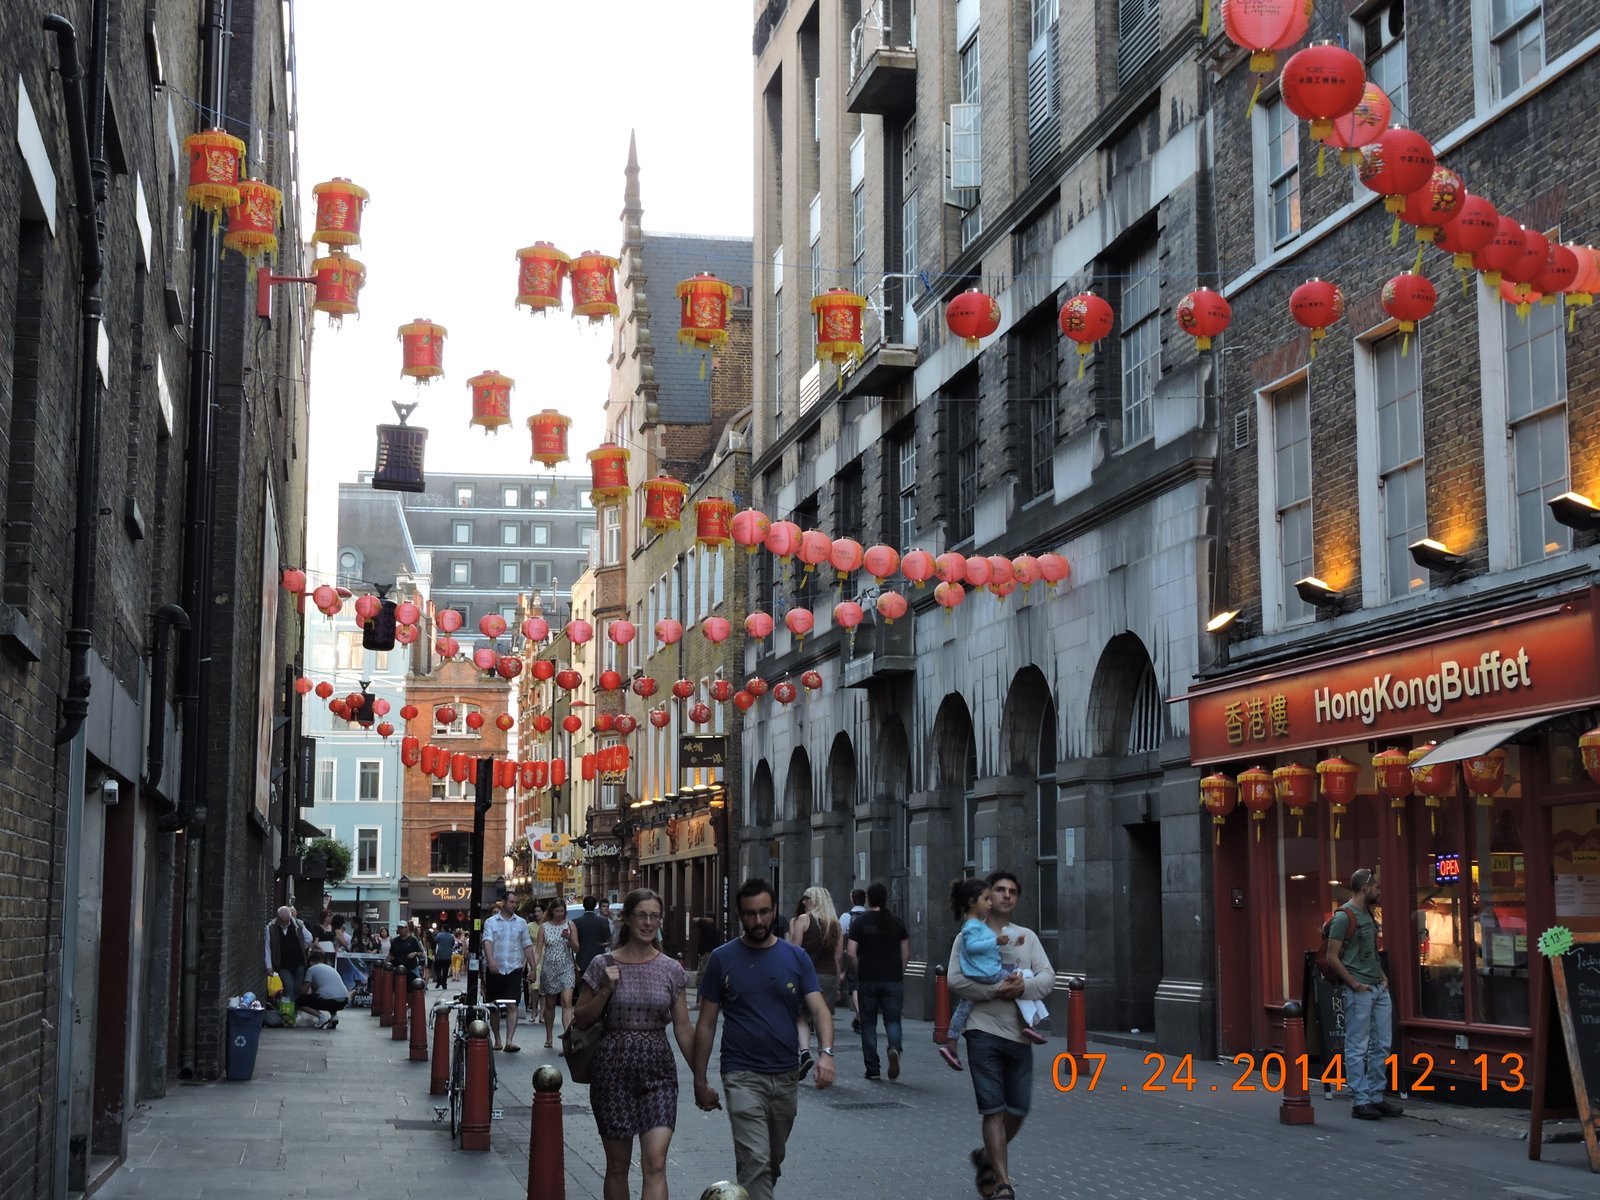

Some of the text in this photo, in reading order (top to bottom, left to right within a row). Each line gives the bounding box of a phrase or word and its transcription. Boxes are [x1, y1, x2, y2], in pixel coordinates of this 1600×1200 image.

[1314, 646, 1531, 725] HongKongBuffet
[1224, 691, 1289, 744] 香港樓
[457, 887, 472, 900] 97
